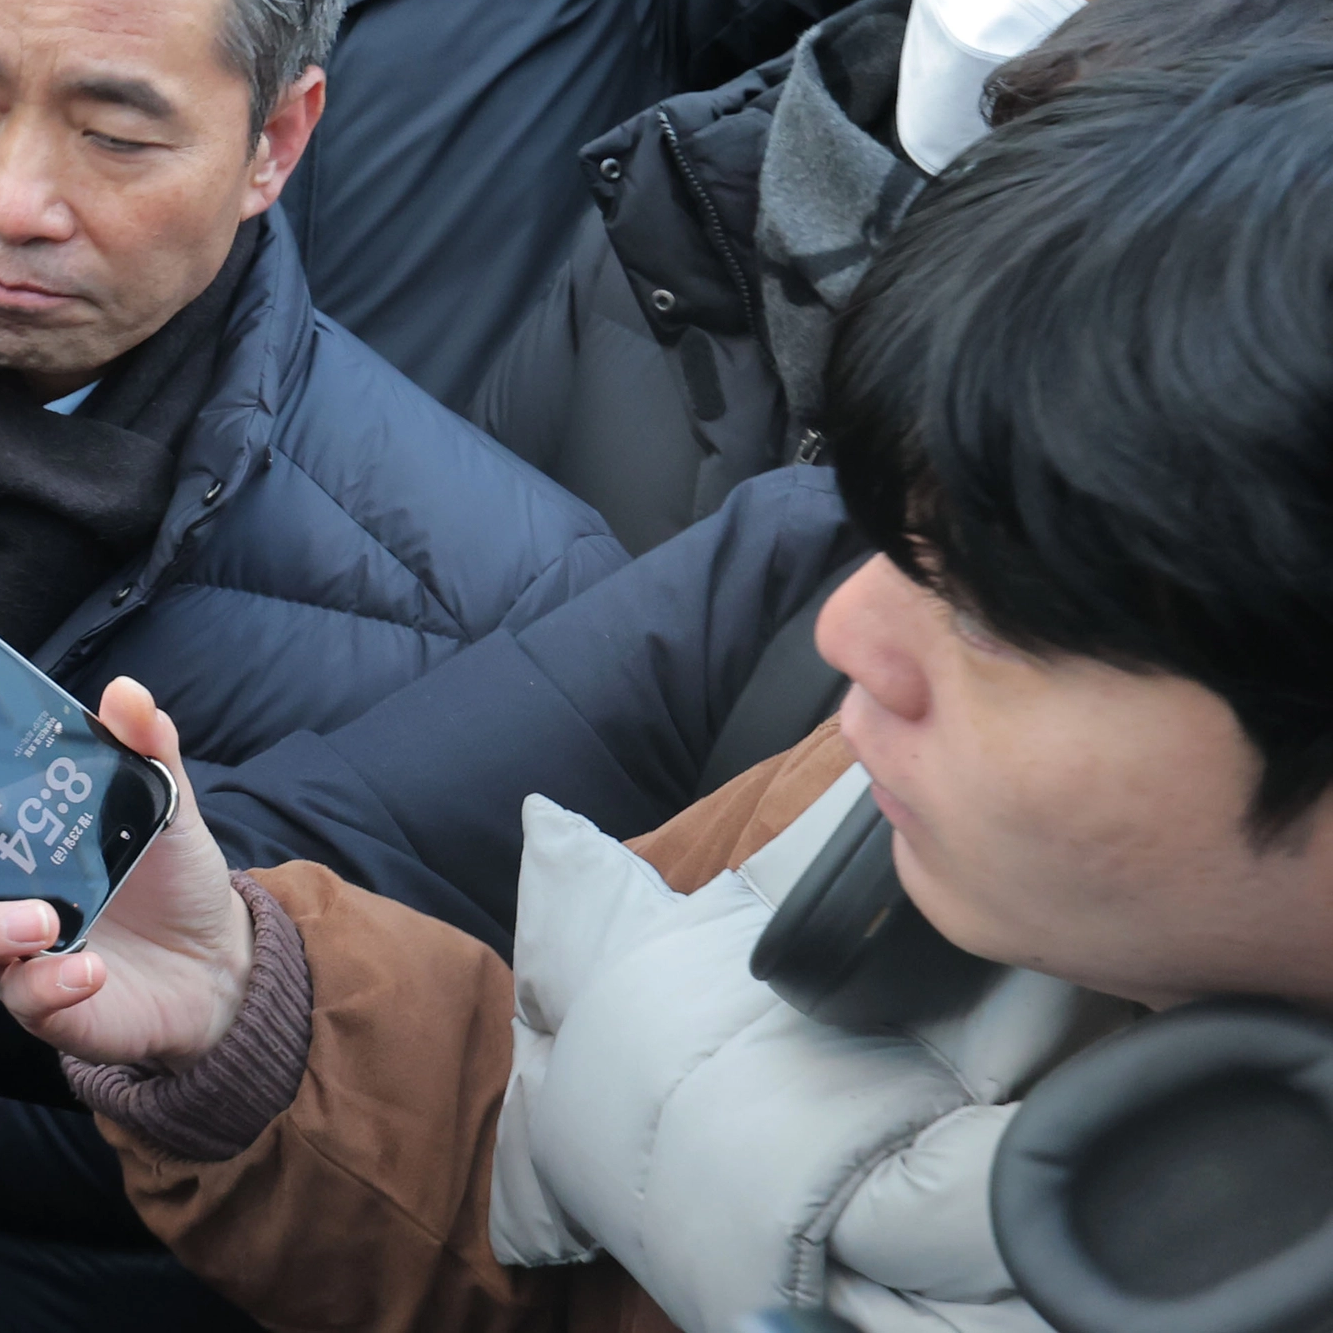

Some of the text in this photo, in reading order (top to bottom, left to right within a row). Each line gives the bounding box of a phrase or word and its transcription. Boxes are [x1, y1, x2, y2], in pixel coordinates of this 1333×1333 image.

[33, 715, 55, 744] 부분적으로
[50, 812, 93, 864] 1월 23일 (금)
